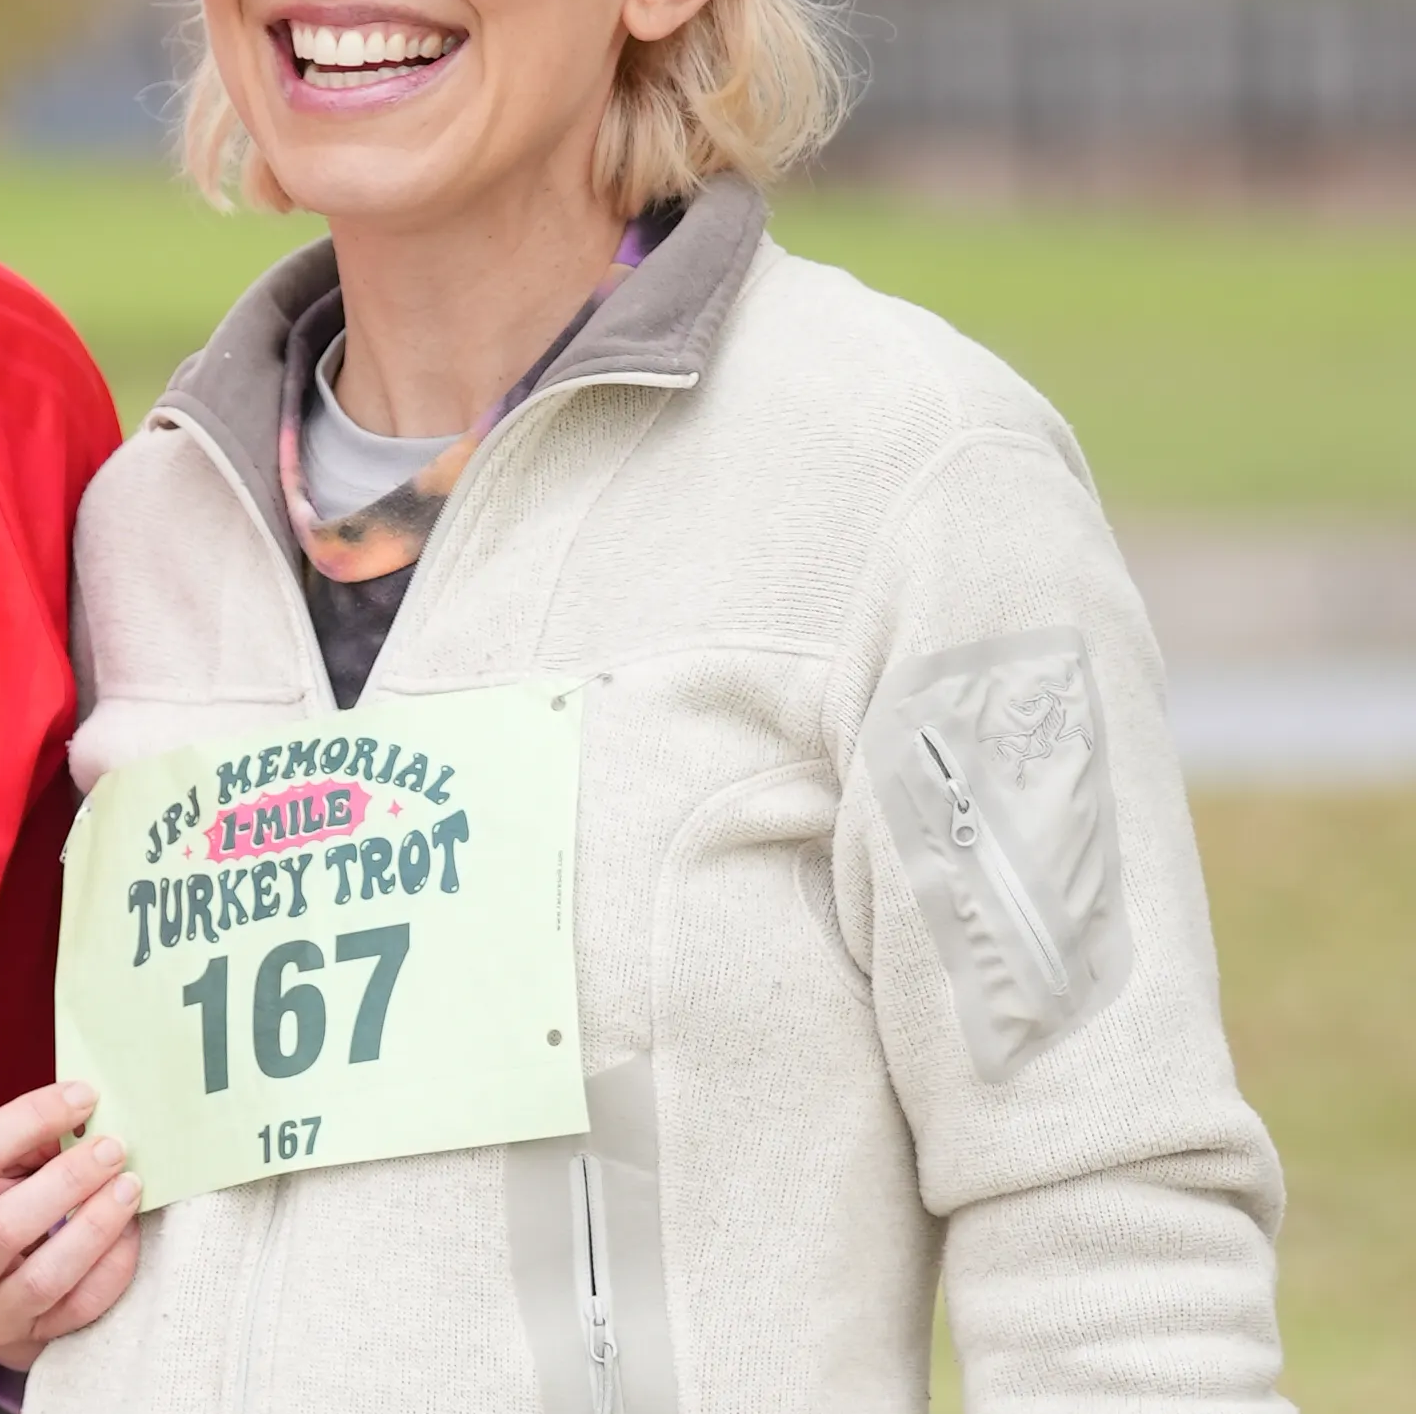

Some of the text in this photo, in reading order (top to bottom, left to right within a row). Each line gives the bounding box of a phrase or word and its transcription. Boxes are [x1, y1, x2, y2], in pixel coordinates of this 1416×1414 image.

[145, 736, 456, 864] JPJ MEMORIAL
[220, 788, 353, 852] 1-MILE
[128, 852, 313, 968] TURKEY
[325, 809, 470, 906] TROT
[182, 922, 411, 1095] 167
[257, 1115, 323, 1164] 167
